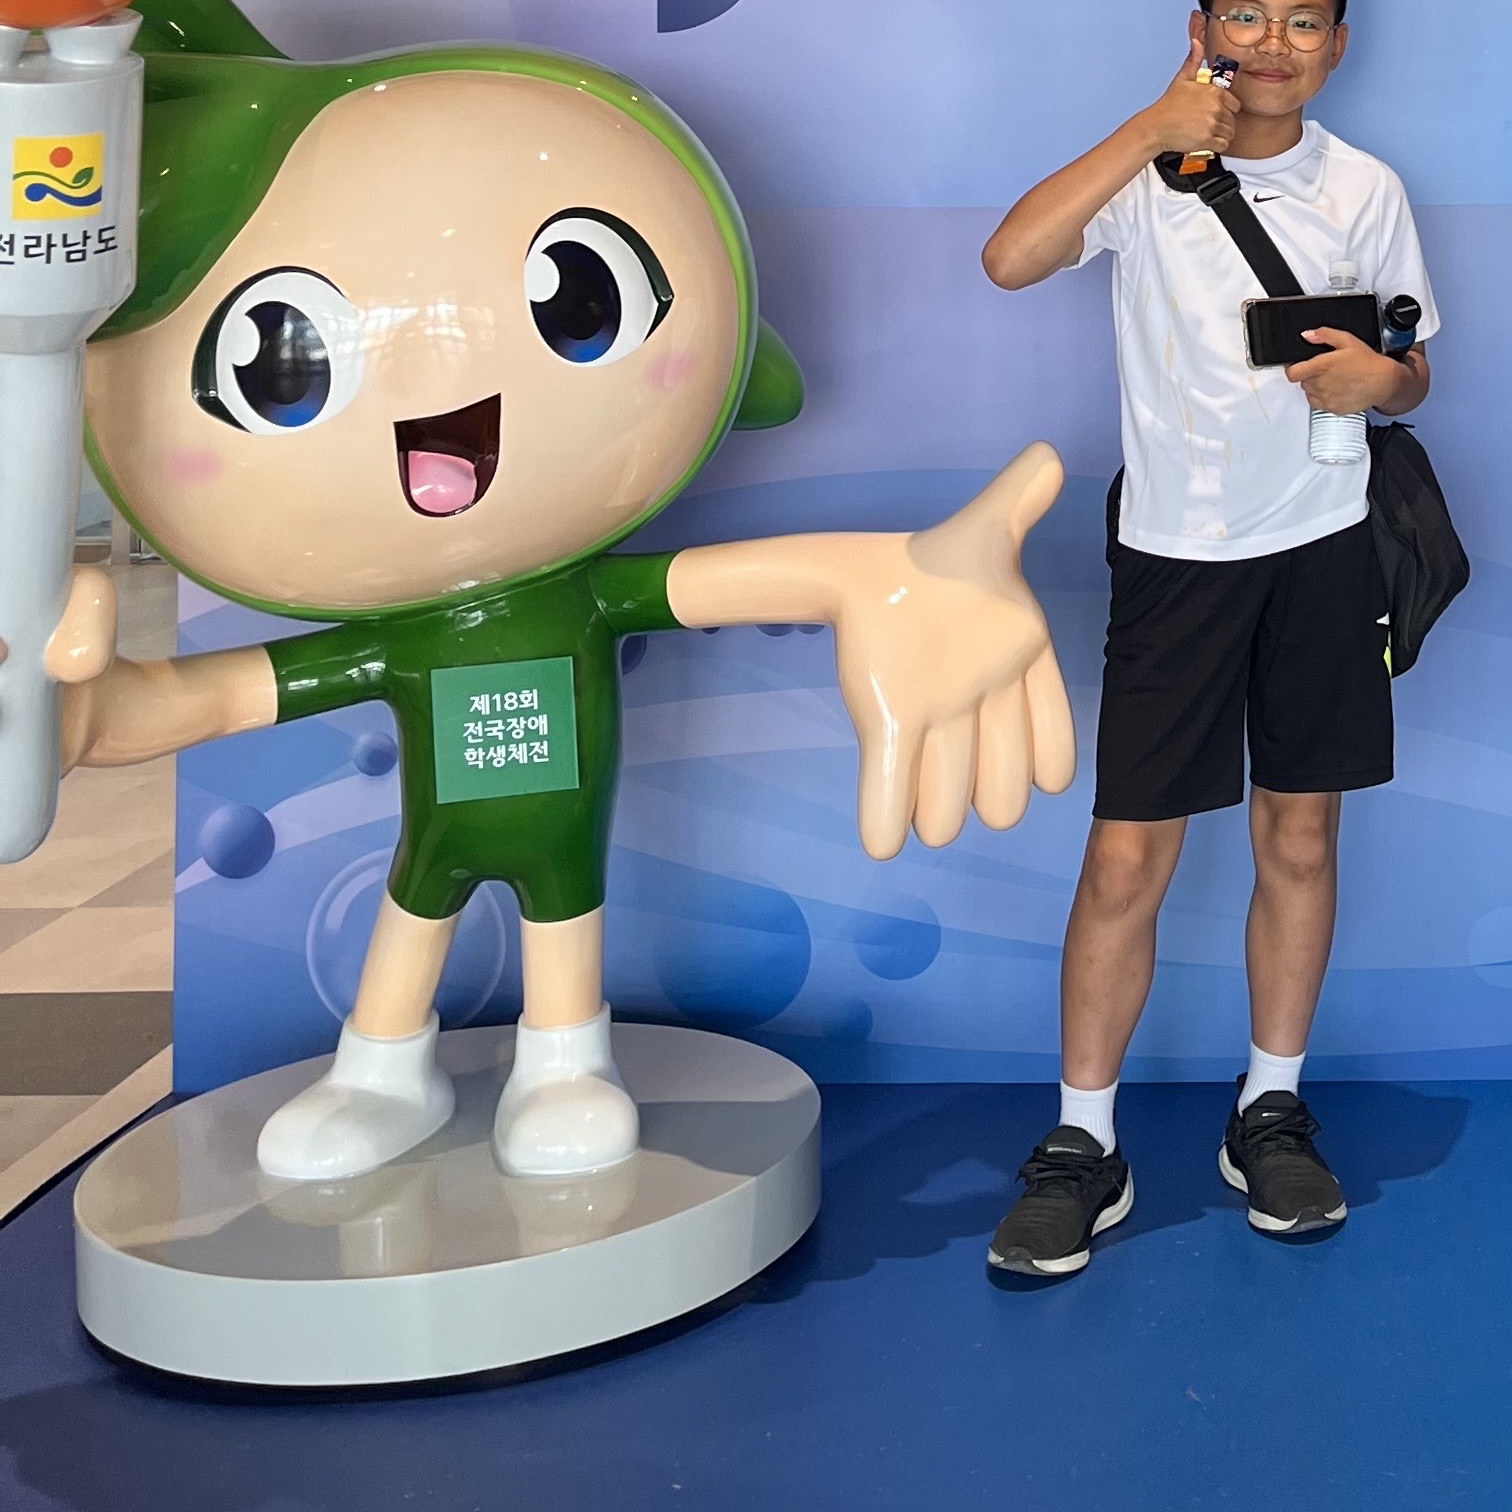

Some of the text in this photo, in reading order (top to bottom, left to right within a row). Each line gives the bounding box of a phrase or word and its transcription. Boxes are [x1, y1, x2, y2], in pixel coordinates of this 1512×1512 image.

[468, 688, 540, 717] 제18회
[462, 713, 549, 744] 전국장애
[463, 740, 550, 770] 학생체전
